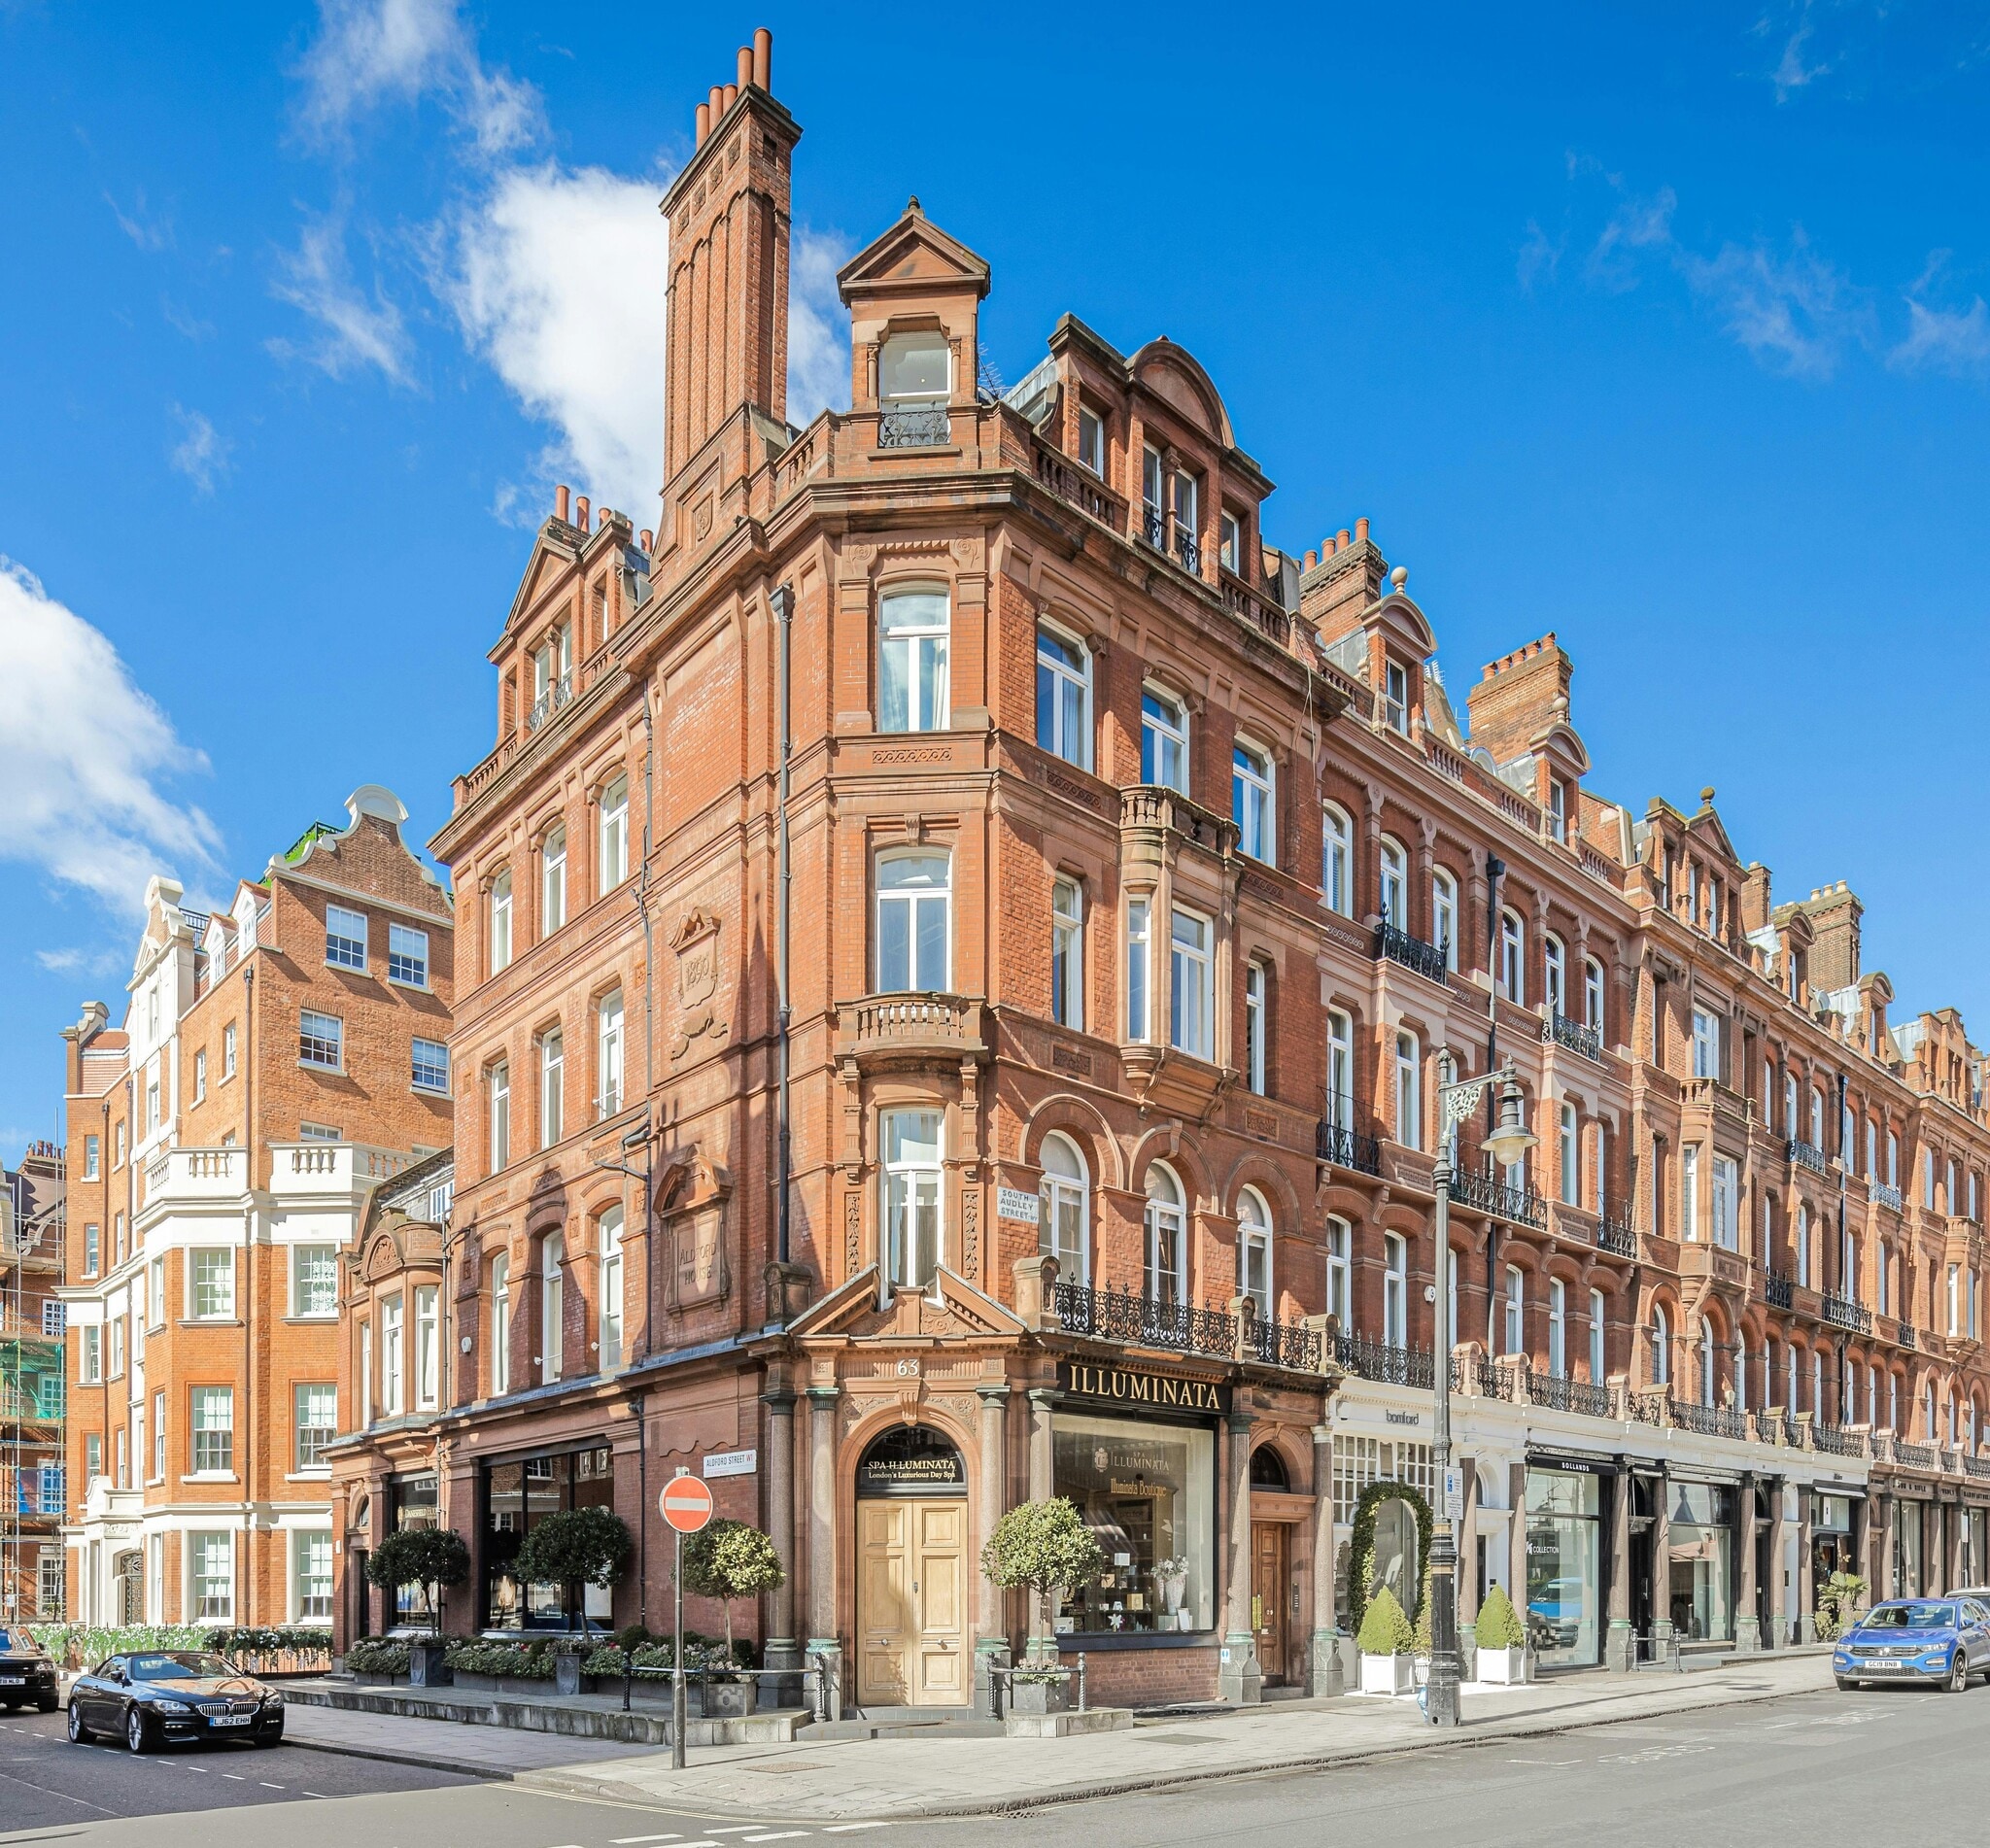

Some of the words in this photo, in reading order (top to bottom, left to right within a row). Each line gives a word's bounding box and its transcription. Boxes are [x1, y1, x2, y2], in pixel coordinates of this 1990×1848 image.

[685, 956, 709, 986] 1890
[1002, 1189, 1029, 1201] SOUTH
[1001, 1198, 1033, 1211] AUDLEY
[679, 1243, 716, 1266] ALDFORD
[685, 1265, 711, 1284] HOUSE
[897, 1359, 918, 1376] 63
[1070, 1365, 1220, 1409] ILLUMINATA
[1386, 1409, 1419, 1425] bamford
[706, 1456, 727, 1467] ALDFORD
[729, 1454, 744, 1464] STREET
[869, 1460, 886, 1469] SPA
[889, 1460, 955, 1470] ILLUMINATA
[1111, 1451, 1170, 1471] ILLUMINATA
[930, 1471, 943, 1480] Day
[1110, 1477, 1138, 1495] Illuminata
[1139, 1480, 1167, 1501] Boutique
